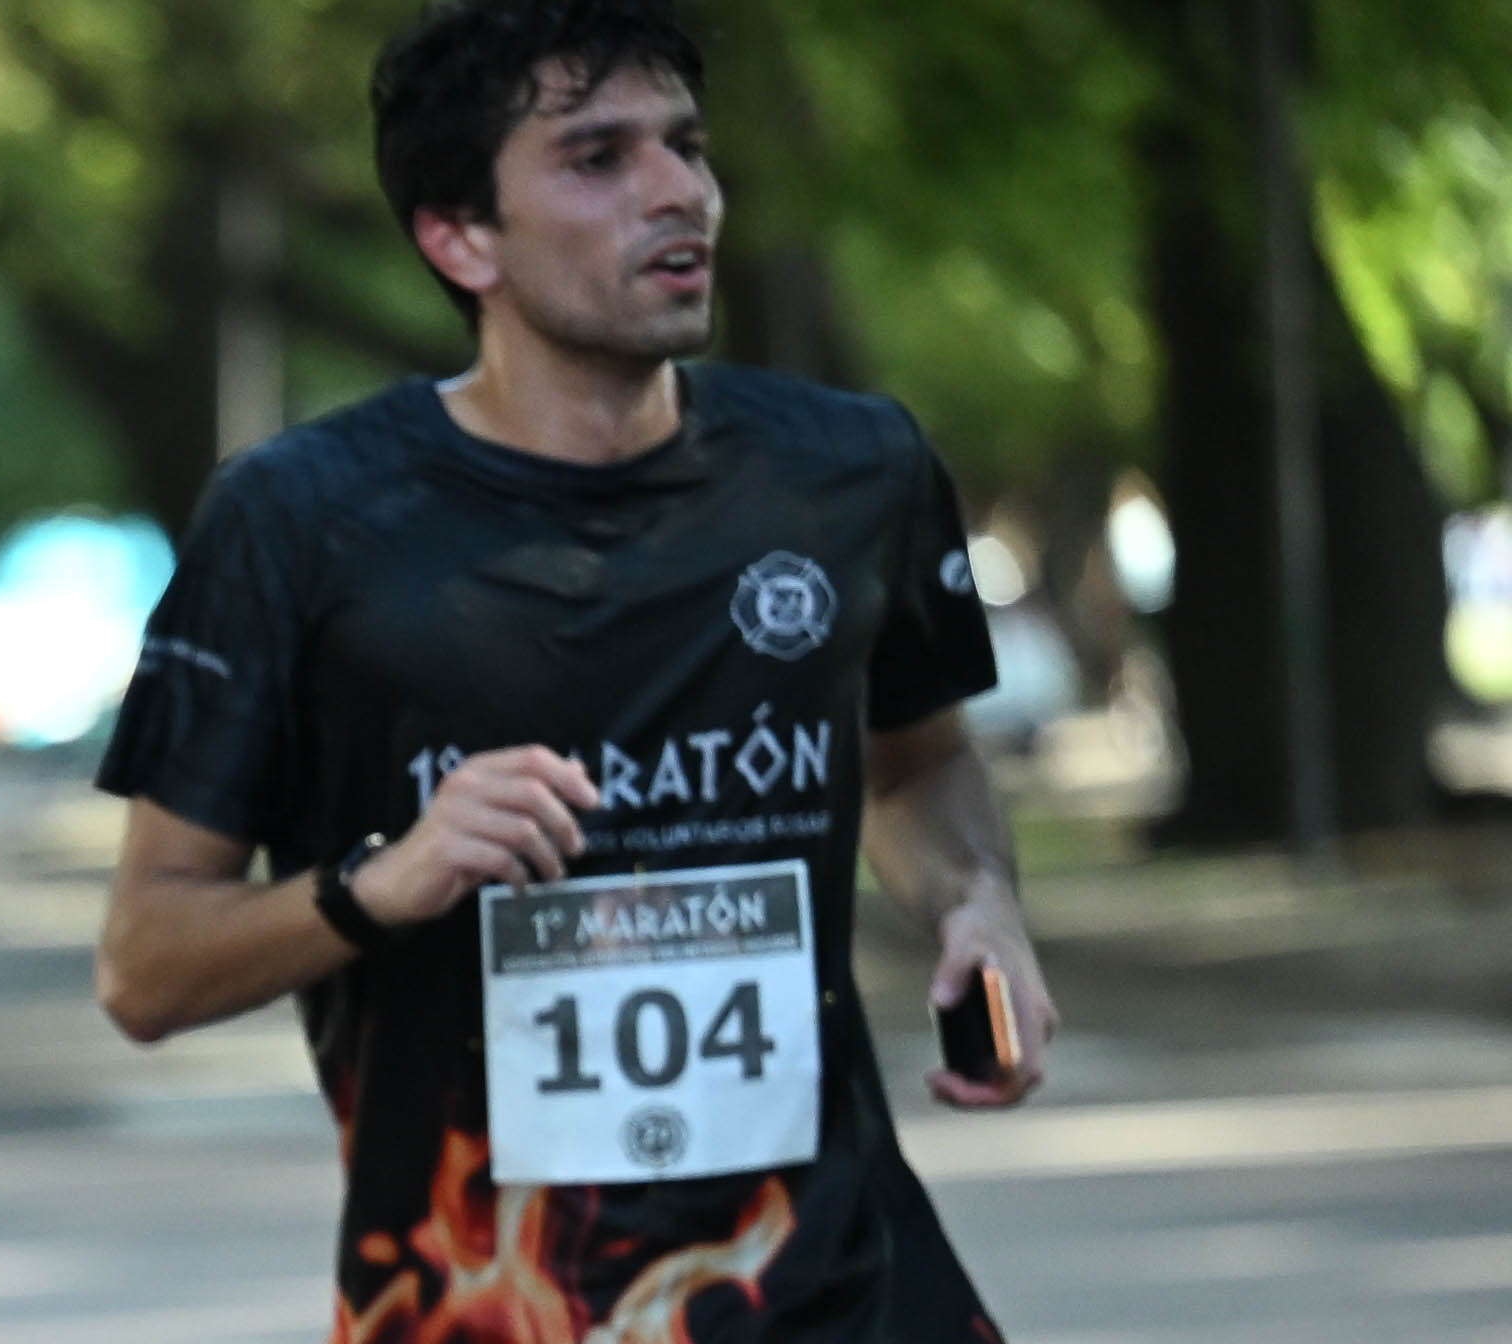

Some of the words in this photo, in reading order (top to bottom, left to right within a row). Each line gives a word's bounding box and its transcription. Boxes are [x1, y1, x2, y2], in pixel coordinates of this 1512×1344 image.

[570, 702, 832, 811] RATÓN
[575, 881, 767, 947] MARATÓN
[533, 979, 776, 1095] 104
